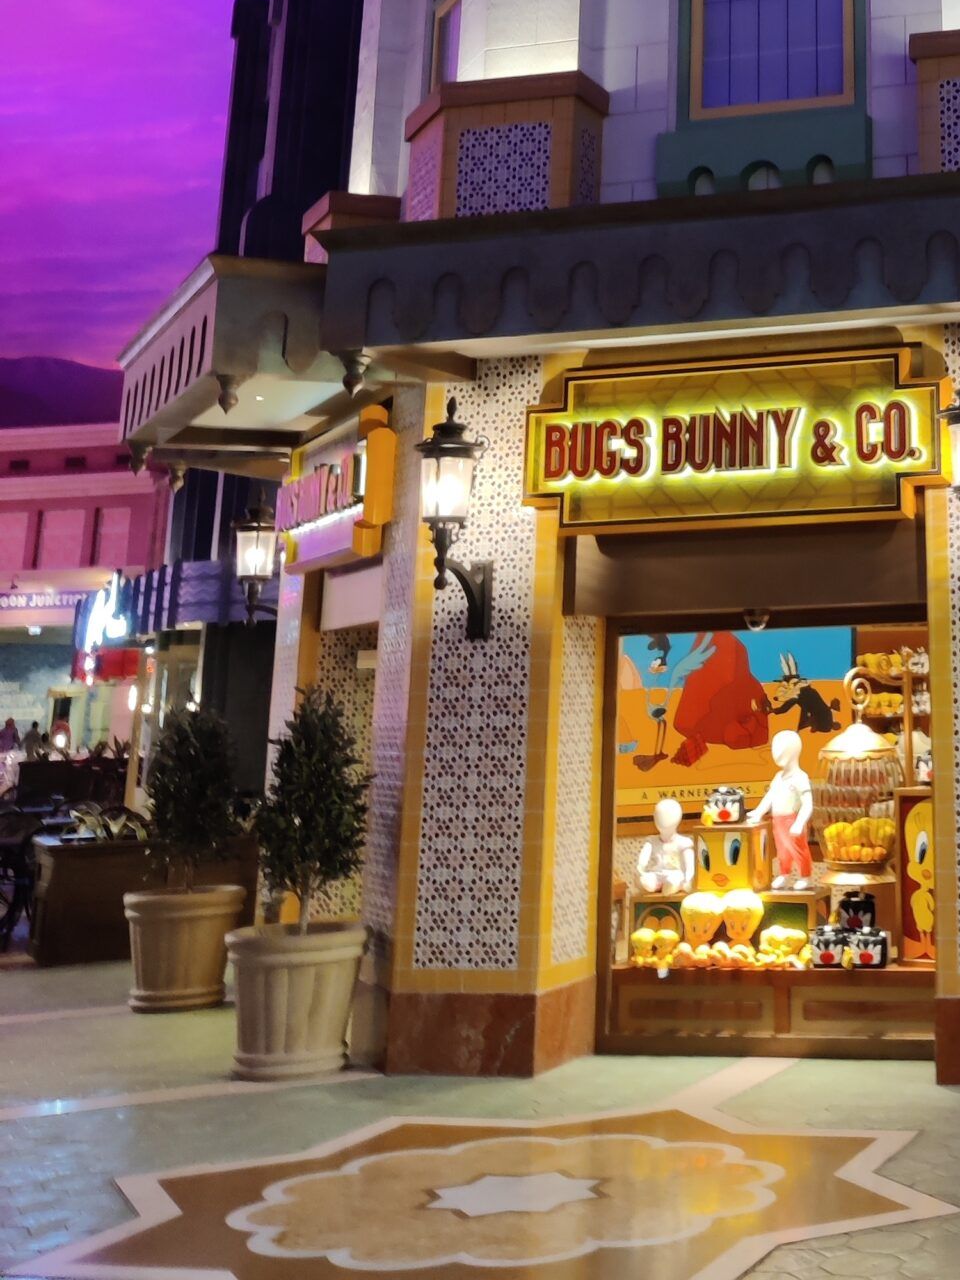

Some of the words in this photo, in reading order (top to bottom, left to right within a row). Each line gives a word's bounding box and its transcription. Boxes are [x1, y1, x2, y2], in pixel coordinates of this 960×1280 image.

[544, 418, 651, 481] BUGS
[661, 405, 801, 474] BUNNY
[811, 418, 847, 468] &
[855, 400, 921, 463] CO.
